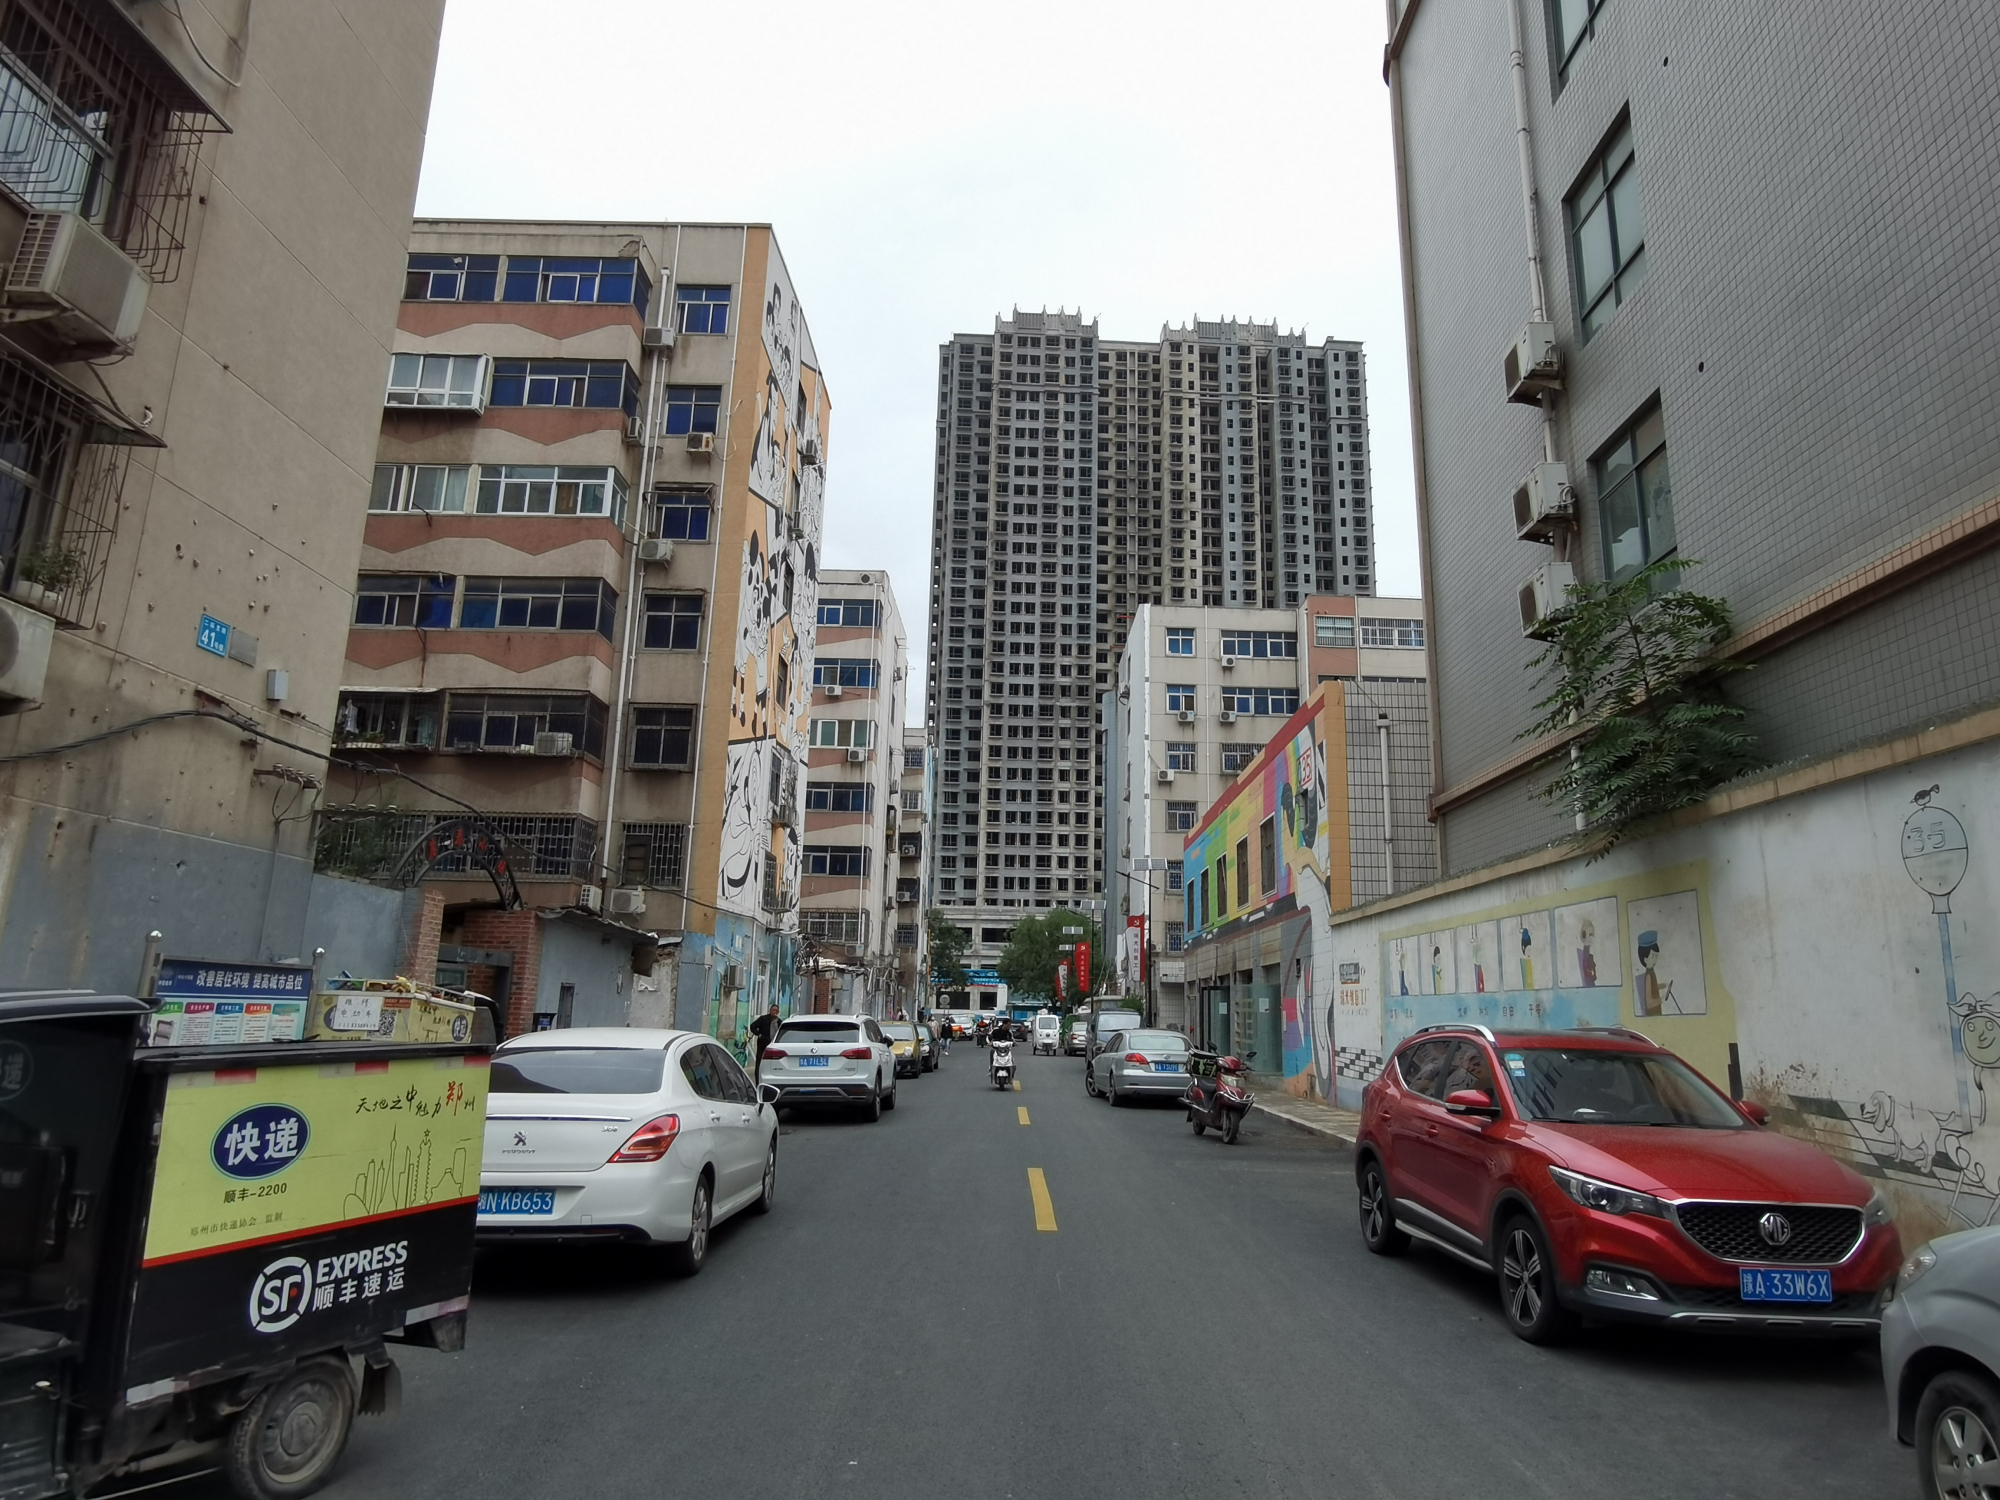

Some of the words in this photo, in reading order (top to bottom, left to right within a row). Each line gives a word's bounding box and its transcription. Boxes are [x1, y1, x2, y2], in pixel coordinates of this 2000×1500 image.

[1910, 821, 1946, 853] 35
[196, 970, 250, 988] 改善居住环境
[253, 974, 303, 990] 提高城市品位
[224, 1117, 299, 1166] 快递
[223, 1182, 288, 1204] 顺丰-2200
[190, 1216, 257, 1237] 郑州市快递协会
[265, 1212, 283, 1224] 监制
[1764, 1216, 1789, 1242] MG
[316, 1240, 409, 1284] EXPRESS
[312, 1267, 405, 1312] 顺丰速运
